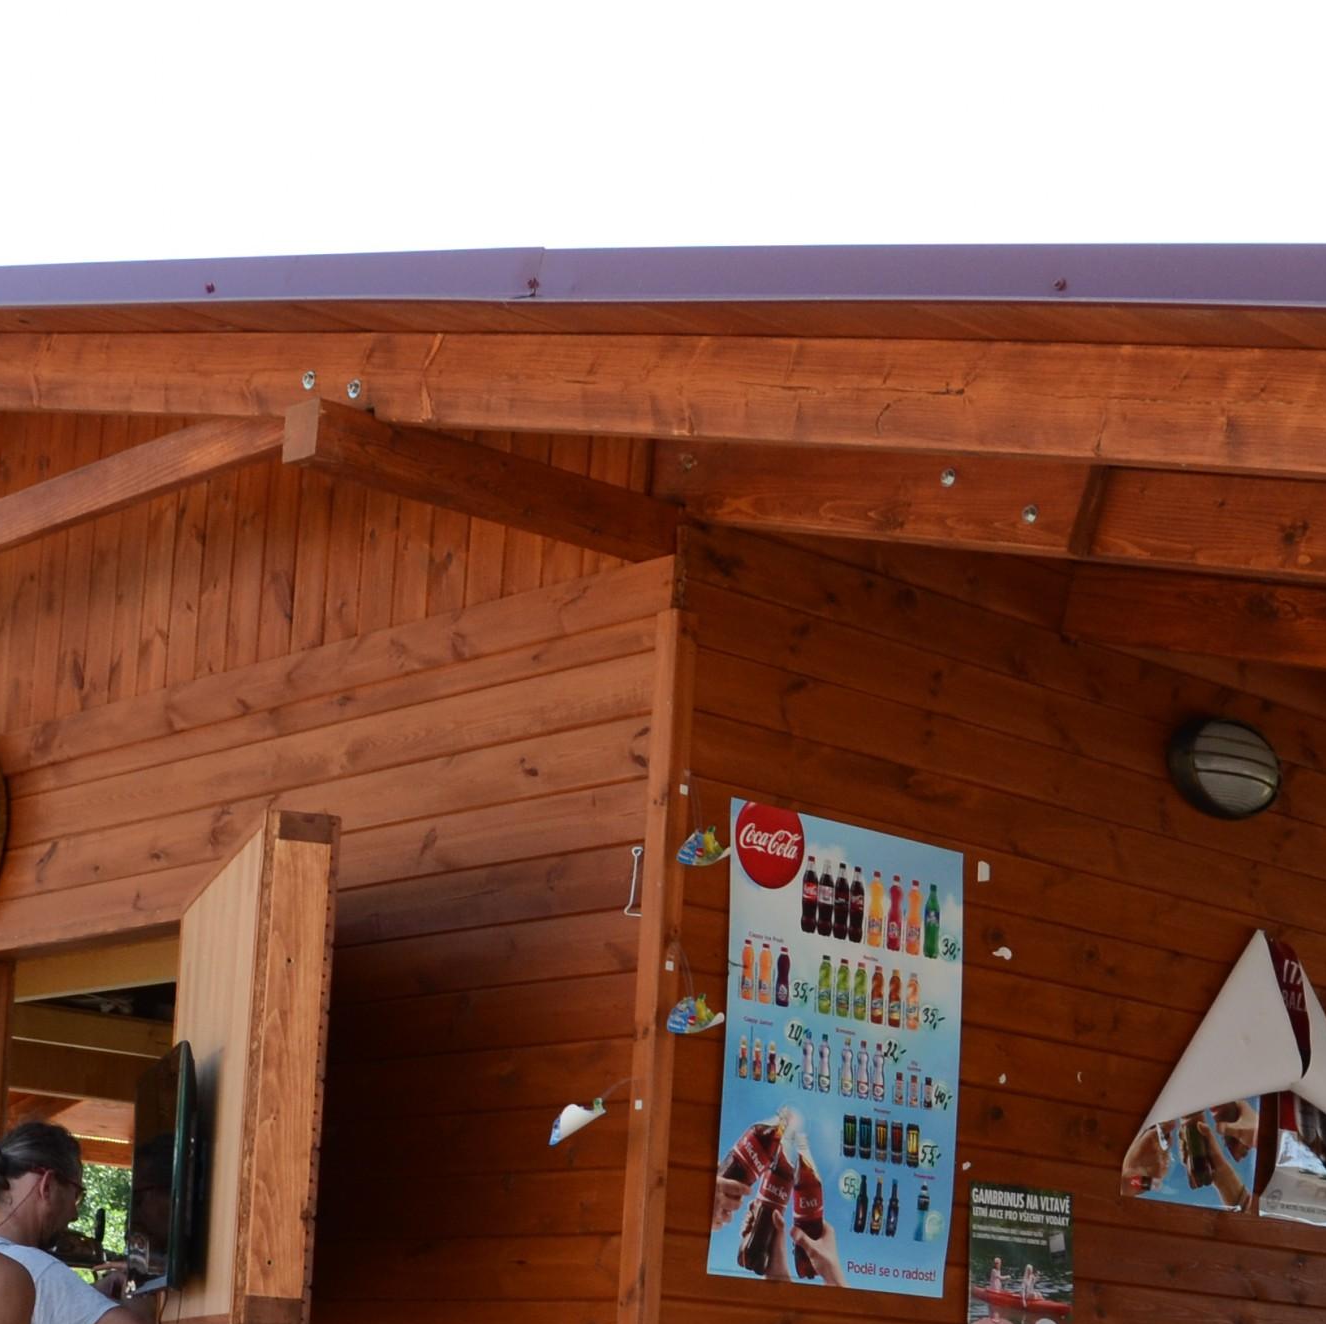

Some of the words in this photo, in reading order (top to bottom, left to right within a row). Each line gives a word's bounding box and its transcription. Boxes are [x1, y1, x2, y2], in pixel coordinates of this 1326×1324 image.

[739, 822, 802, 860] Coca-Cola
[972, 1187, 1025, 1209] GAMBRINUS
[1026, 1193, 1039, 1210] NA
[1039, 1195, 1071, 1215] VLTAVĚ
[989, 1208, 1004, 1220] AKCE
[1005, 1209, 1018, 1221] PRO
[847, 1260, 876, 1276] Poděl
[880, 1266, 891, 1277] se
[893, 1268, 900, 1279] o
[902, 1269, 937, 1283] radost!
